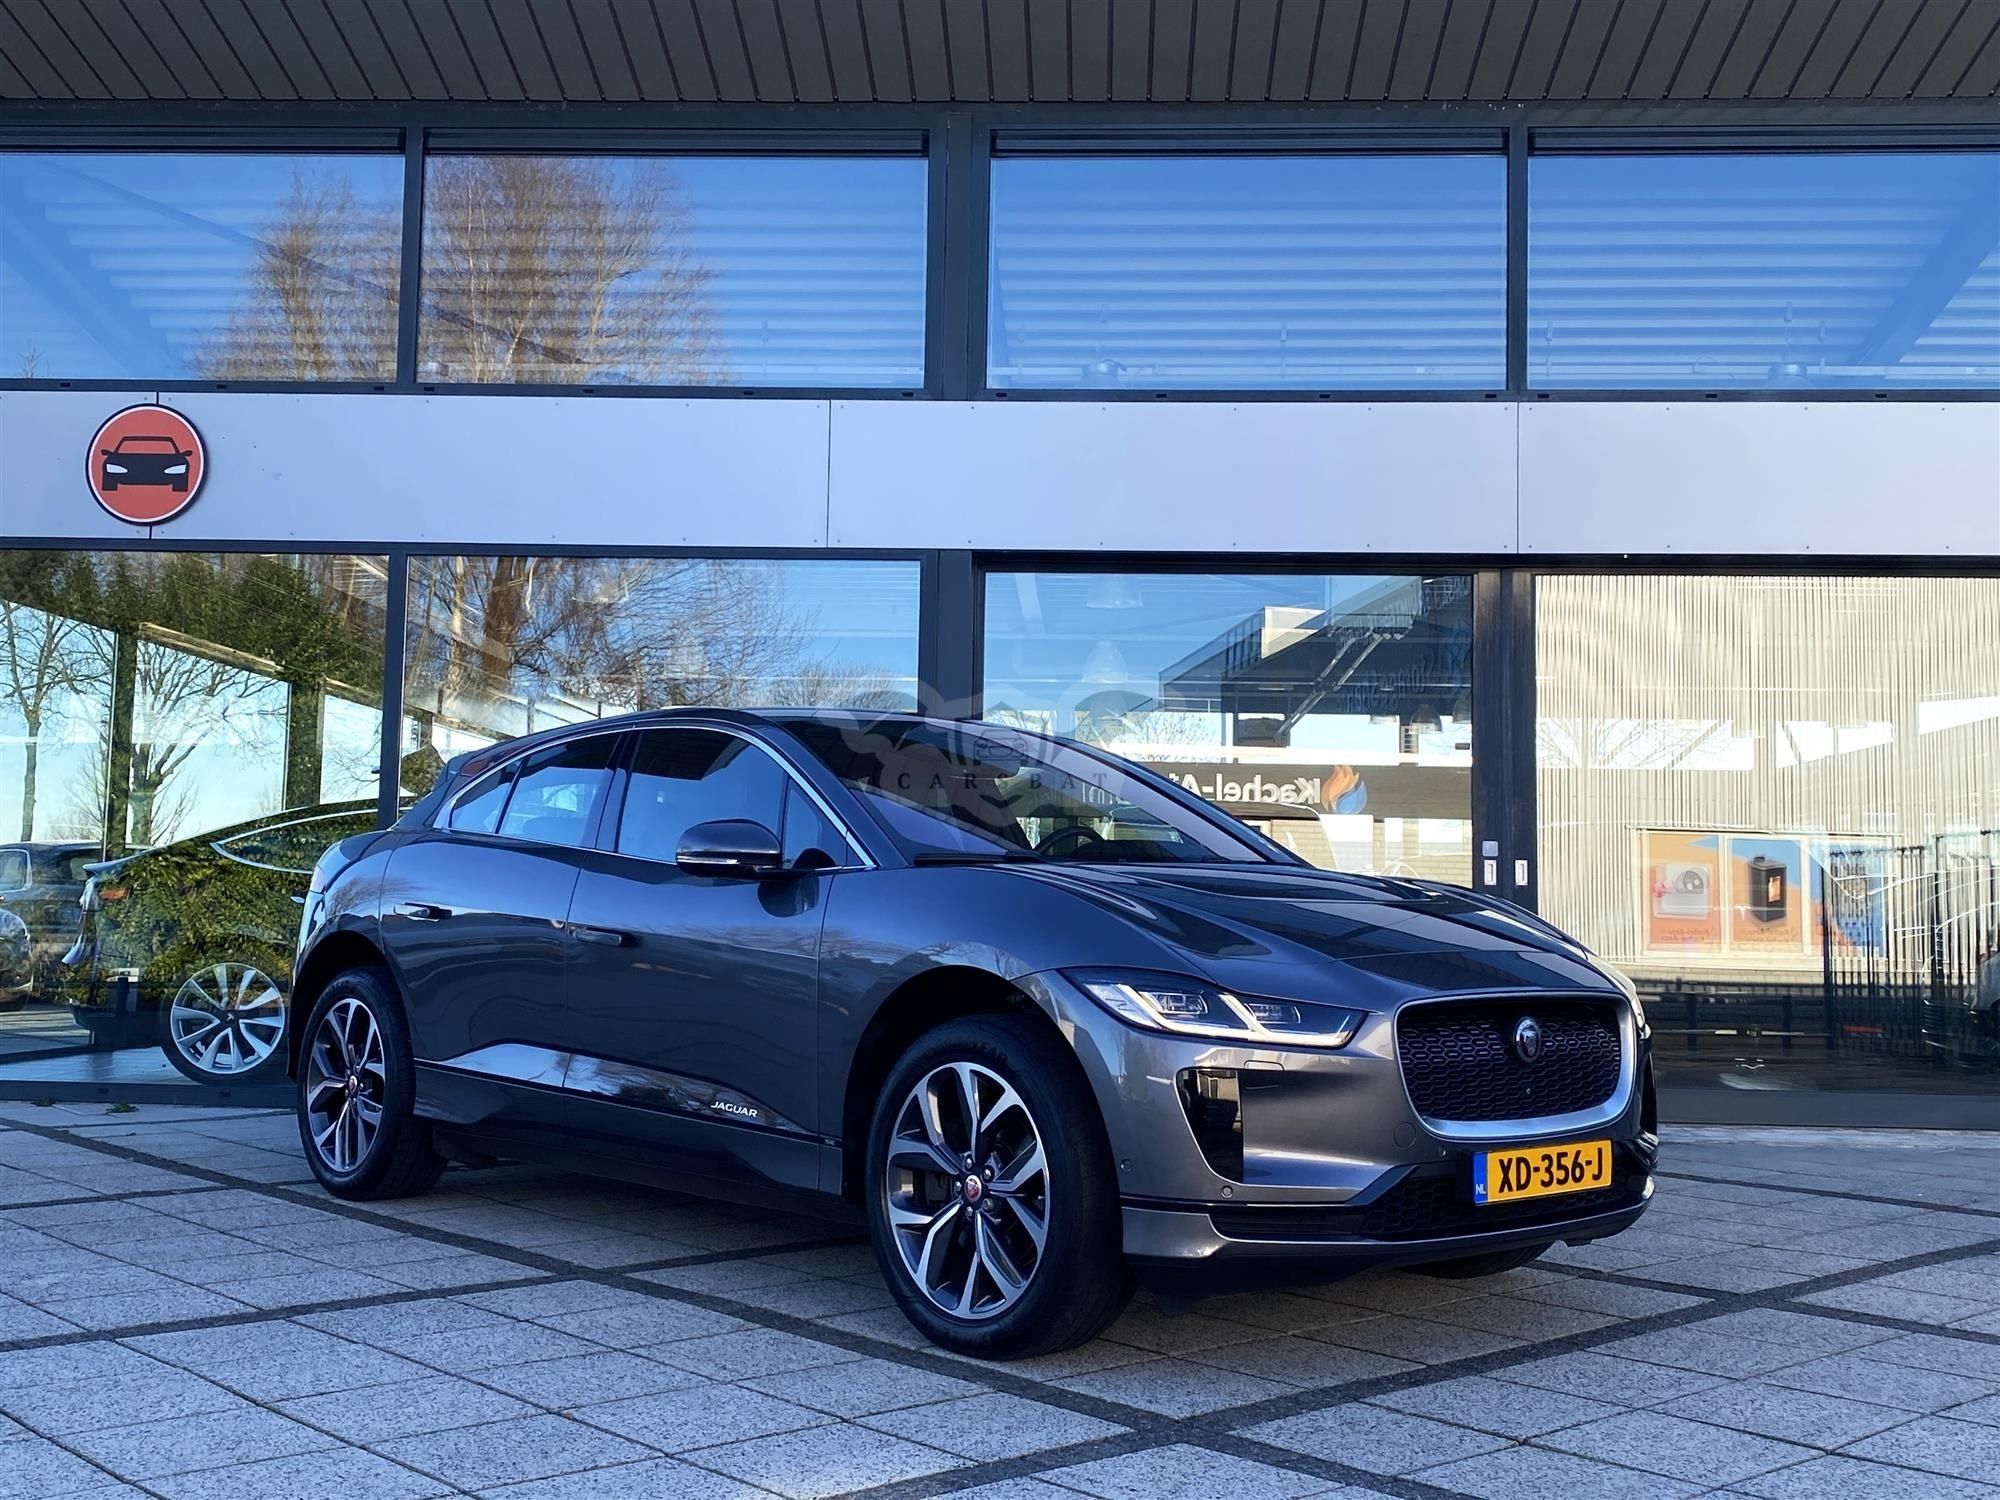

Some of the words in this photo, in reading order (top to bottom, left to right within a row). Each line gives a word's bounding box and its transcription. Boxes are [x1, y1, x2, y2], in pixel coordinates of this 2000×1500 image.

[711, 1101, 758, 1118] JAGUAR
[1475, 1183, 1487, 1195] NL
[1498, 1147, 1603, 1193] XD-356-J
